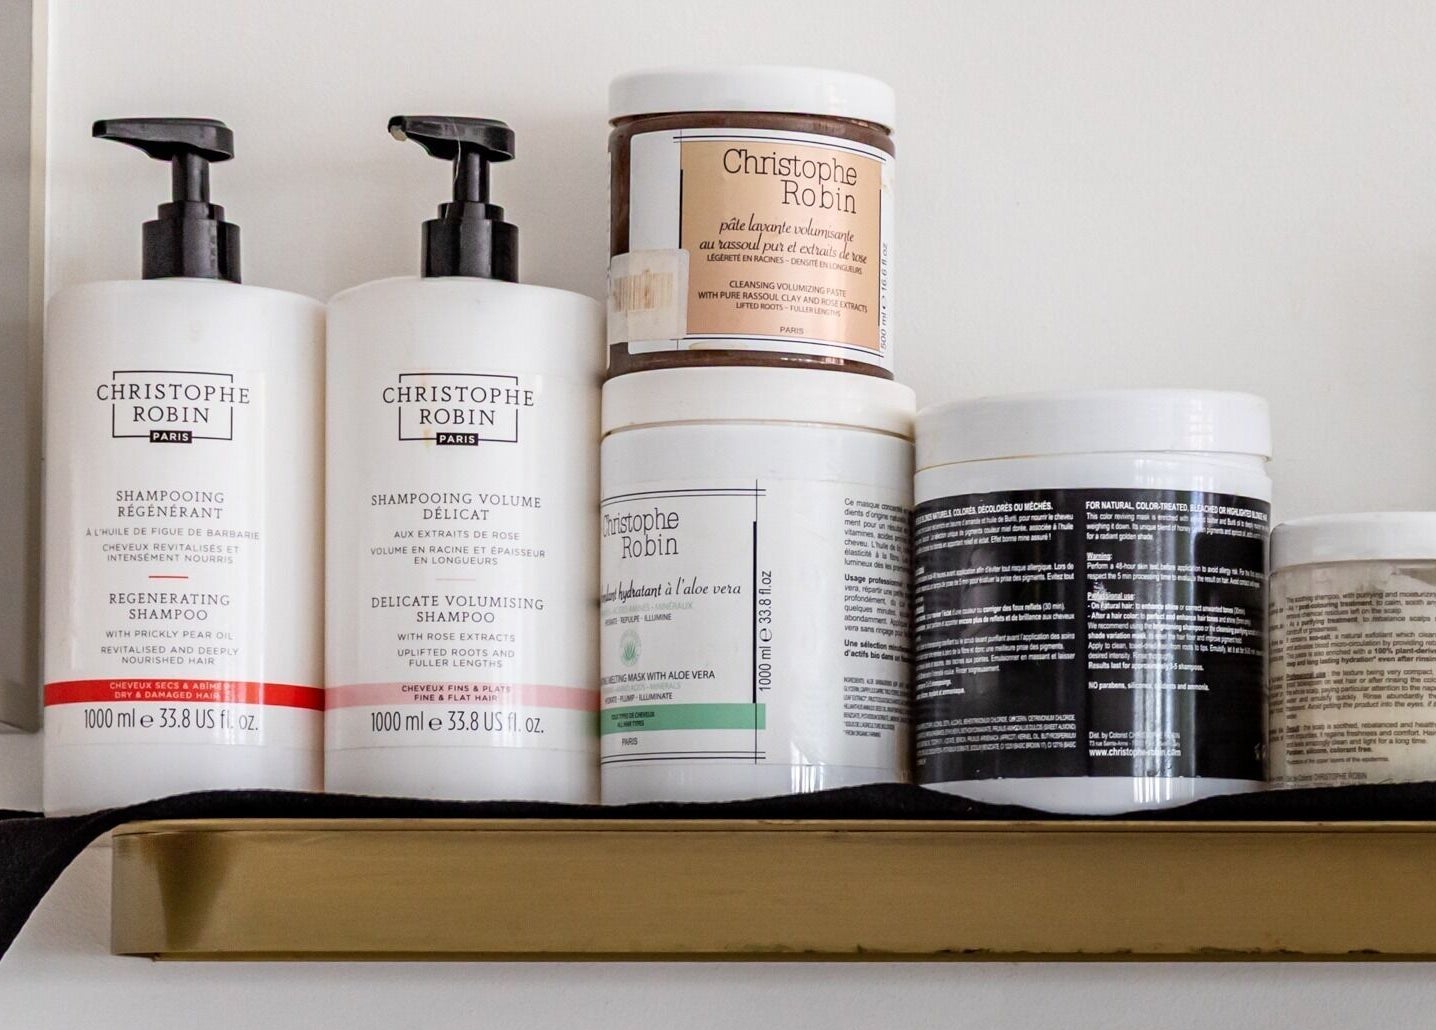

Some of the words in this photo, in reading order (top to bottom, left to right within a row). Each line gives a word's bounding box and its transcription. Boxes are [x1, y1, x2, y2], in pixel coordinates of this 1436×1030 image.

[723, 148, 858, 186] Christophe
[781, 180, 857, 214] Robin
[719, 217, 746, 234] pâte
[729, 280, 775, 289] CLEANSING
[777, 282, 825, 295] VOLUMIZING
[827, 287, 846, 297] PASTE
[780, 326, 804, 334] PARIS
[96, 383, 250, 405] CHRISTOPHE
[382, 385, 534, 407] CHRISTOPHE
[132, 406, 210, 423] ROBIN
[419, 408, 495, 425] ROBIN
[152, 432, 189, 442] PARIS
[439, 434, 475, 444] PARIS
[115, 490, 225, 504] SHAMPOOING
[371, 493, 472, 507] SHAMPOOING
[479, 494, 541, 508] VOLUME
[117, 505, 222, 519] RÉGÉNÉRANT
[423, 507, 489, 520] DÉLICAT
[394, 530, 414, 539] AUX
[417, 530, 469, 540] EXTRAITS
[473, 530, 488, 540] DE
[492, 531, 520, 541] ROSE
[621, 534, 679, 559] Robin
[665, 582, 672, 595] à
[713, 584, 741, 595] vera
[109, 594, 230, 606] REGENERATING
[371, 596, 438, 610] DELICATE
[445, 596, 544, 611] VOLUMISING
[128, 608, 208, 621] SHAMPOO
[416, 611, 494, 623] SHAMPOO
[759, 599, 771, 624] 33.8
[397, 633, 423, 642] WITH
[427, 633, 455, 642] ROSE
[459, 633, 515, 643] EXTRACTS
[759, 646, 771, 659] ml
[668, 671, 690, 679] ALOE
[692, 670, 715, 679] VERA
[759, 663, 771, 692] 1000
[83, 708, 113, 728] 1000
[117, 708, 136, 728] ml
[159, 709, 190, 729] 33.8
[195, 711, 214, 729] US
[238, 716, 258, 732] oz.
